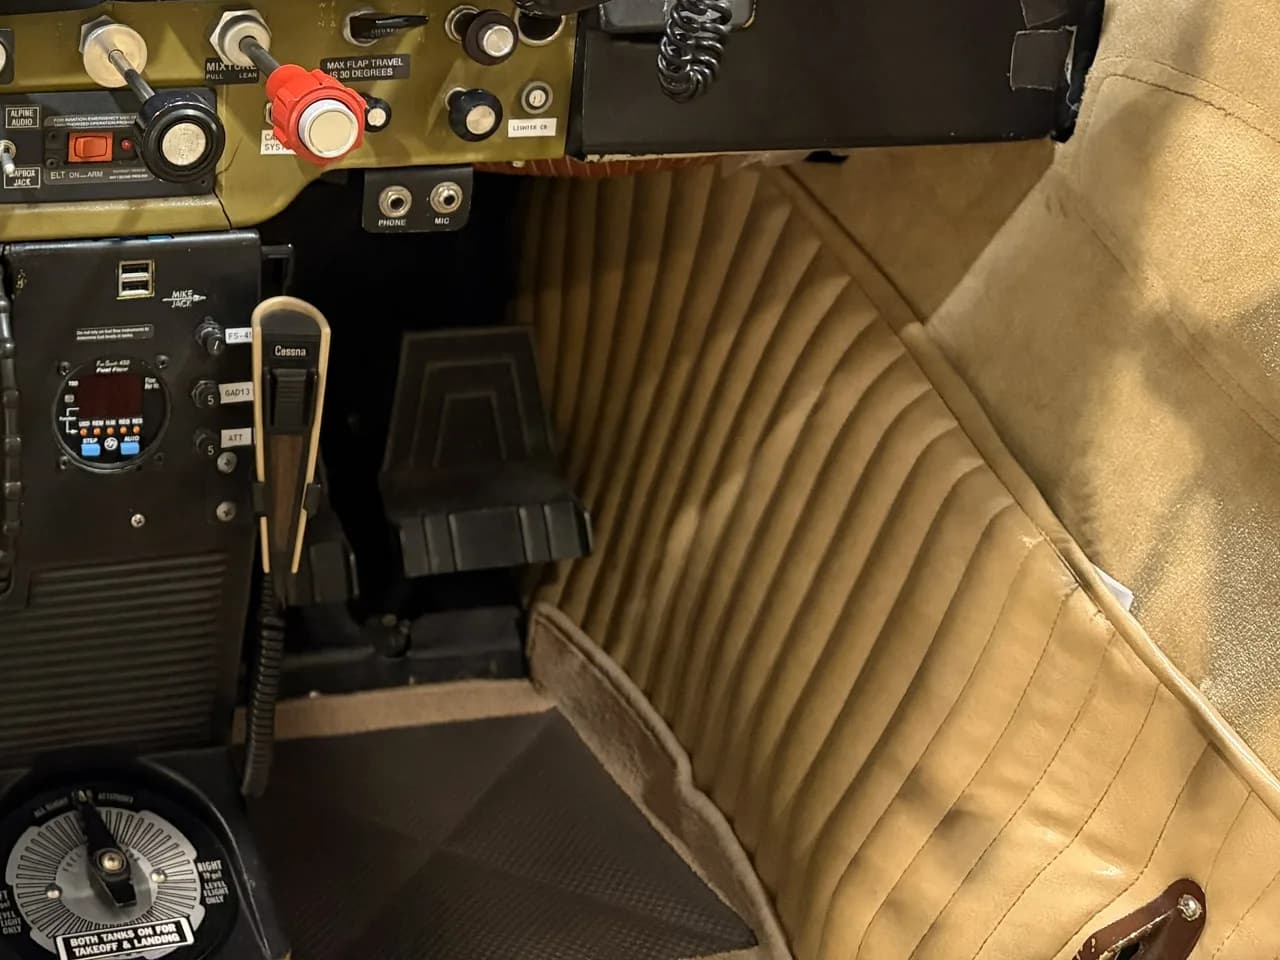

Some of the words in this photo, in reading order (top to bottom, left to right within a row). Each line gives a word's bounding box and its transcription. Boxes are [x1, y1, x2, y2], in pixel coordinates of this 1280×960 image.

[371, 58, 403, 67] TRAVEL
[340, 71, 349, 79] 30
[352, 69, 393, 77] DEGREES
[51, 171, 65, 179] ELT
[378, 218, 406, 227] PHONE
[435, 217, 450, 225] MIC
[275, 345, 306, 357] Cessna
[225, 388, 250, 397] GAD13
[228, 434, 242, 442] ATT
[70, 935, 99, 947] BOTH
[102, 931, 135, 942] TANKS
[138, 927, 153, 937] ON
[156, 923, 176, 935] FOR
[73, 943, 119, 957] TAKEOFF
[123, 940, 131, 950] &
[134, 933, 179, 946] LANDING
